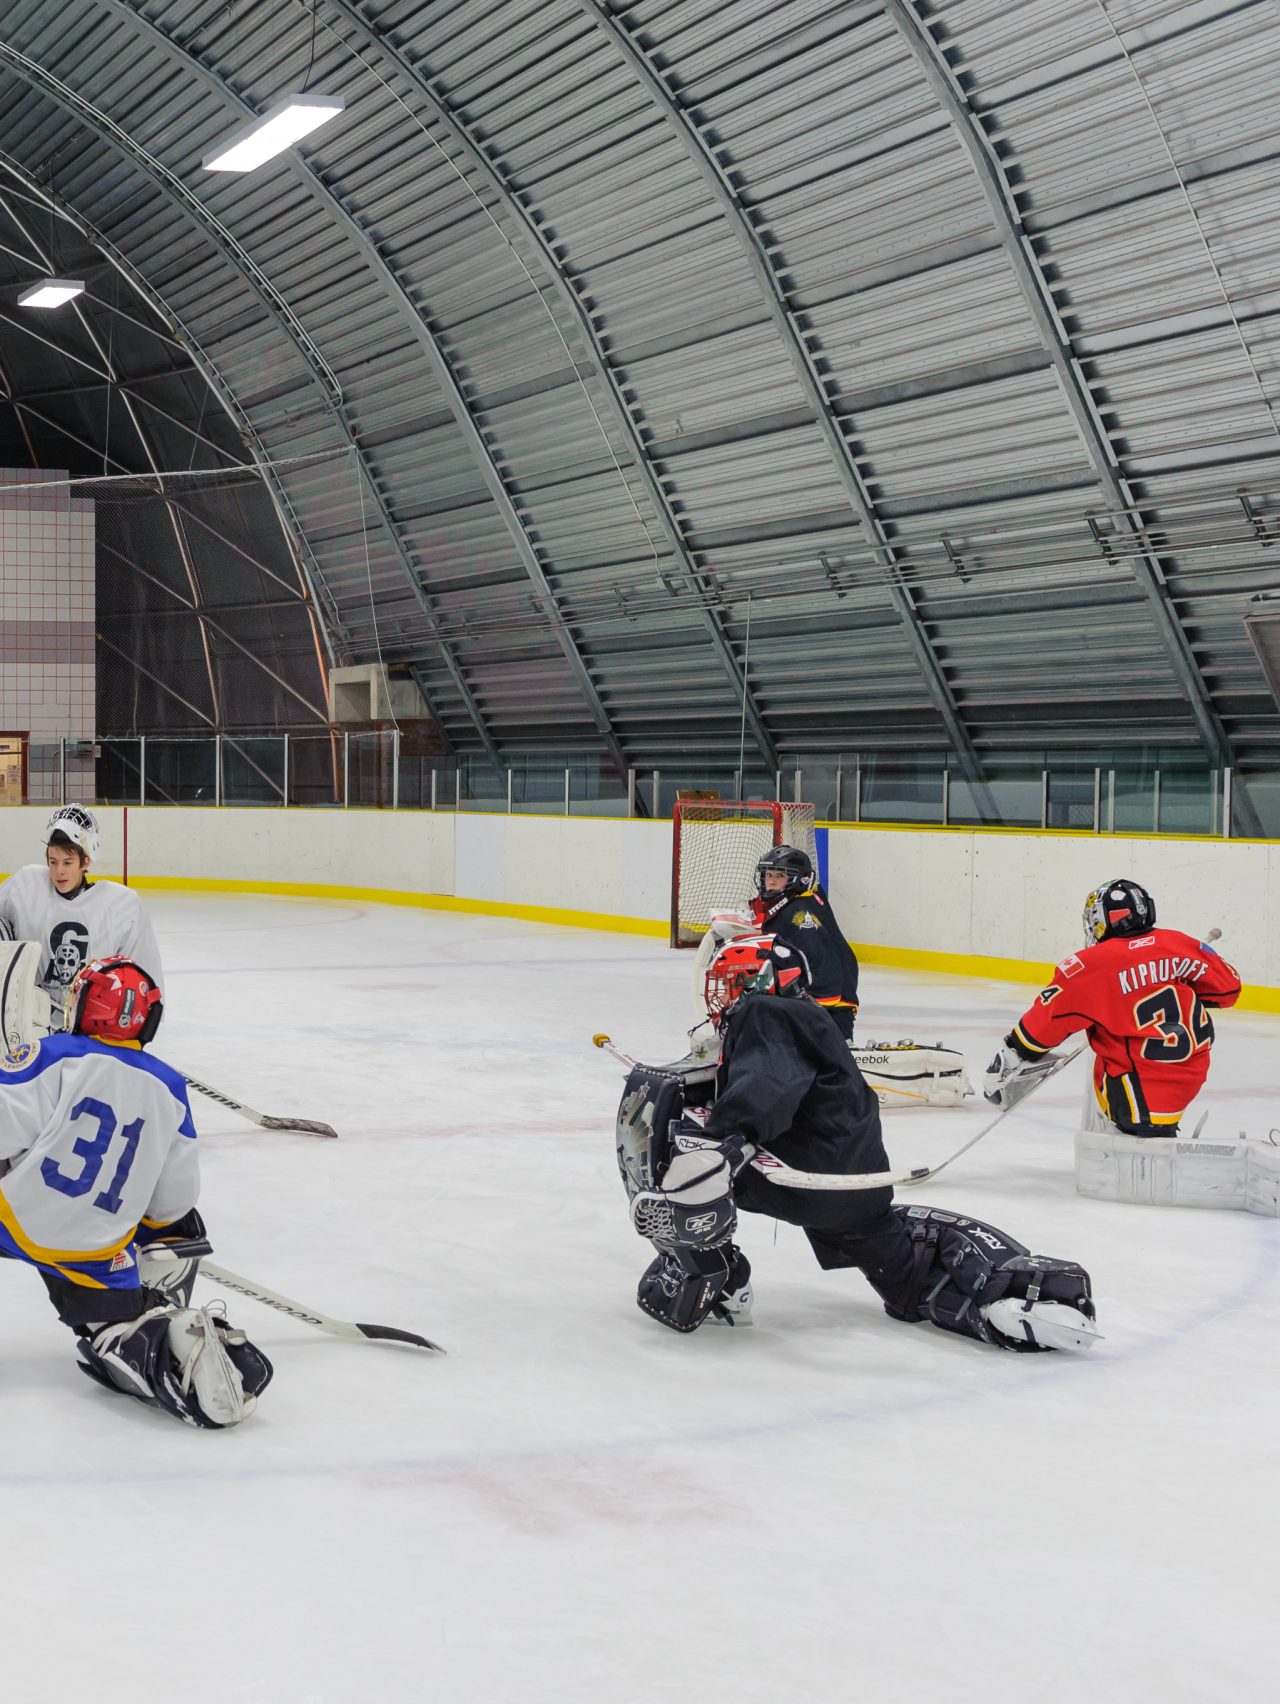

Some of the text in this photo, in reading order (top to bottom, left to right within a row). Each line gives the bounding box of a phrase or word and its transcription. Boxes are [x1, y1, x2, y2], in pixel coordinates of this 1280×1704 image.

[1117, 956, 1210, 996] KIPRUSOFF
[1132, 984, 1216, 1064] 34
[39, 1096, 147, 1215] 31
